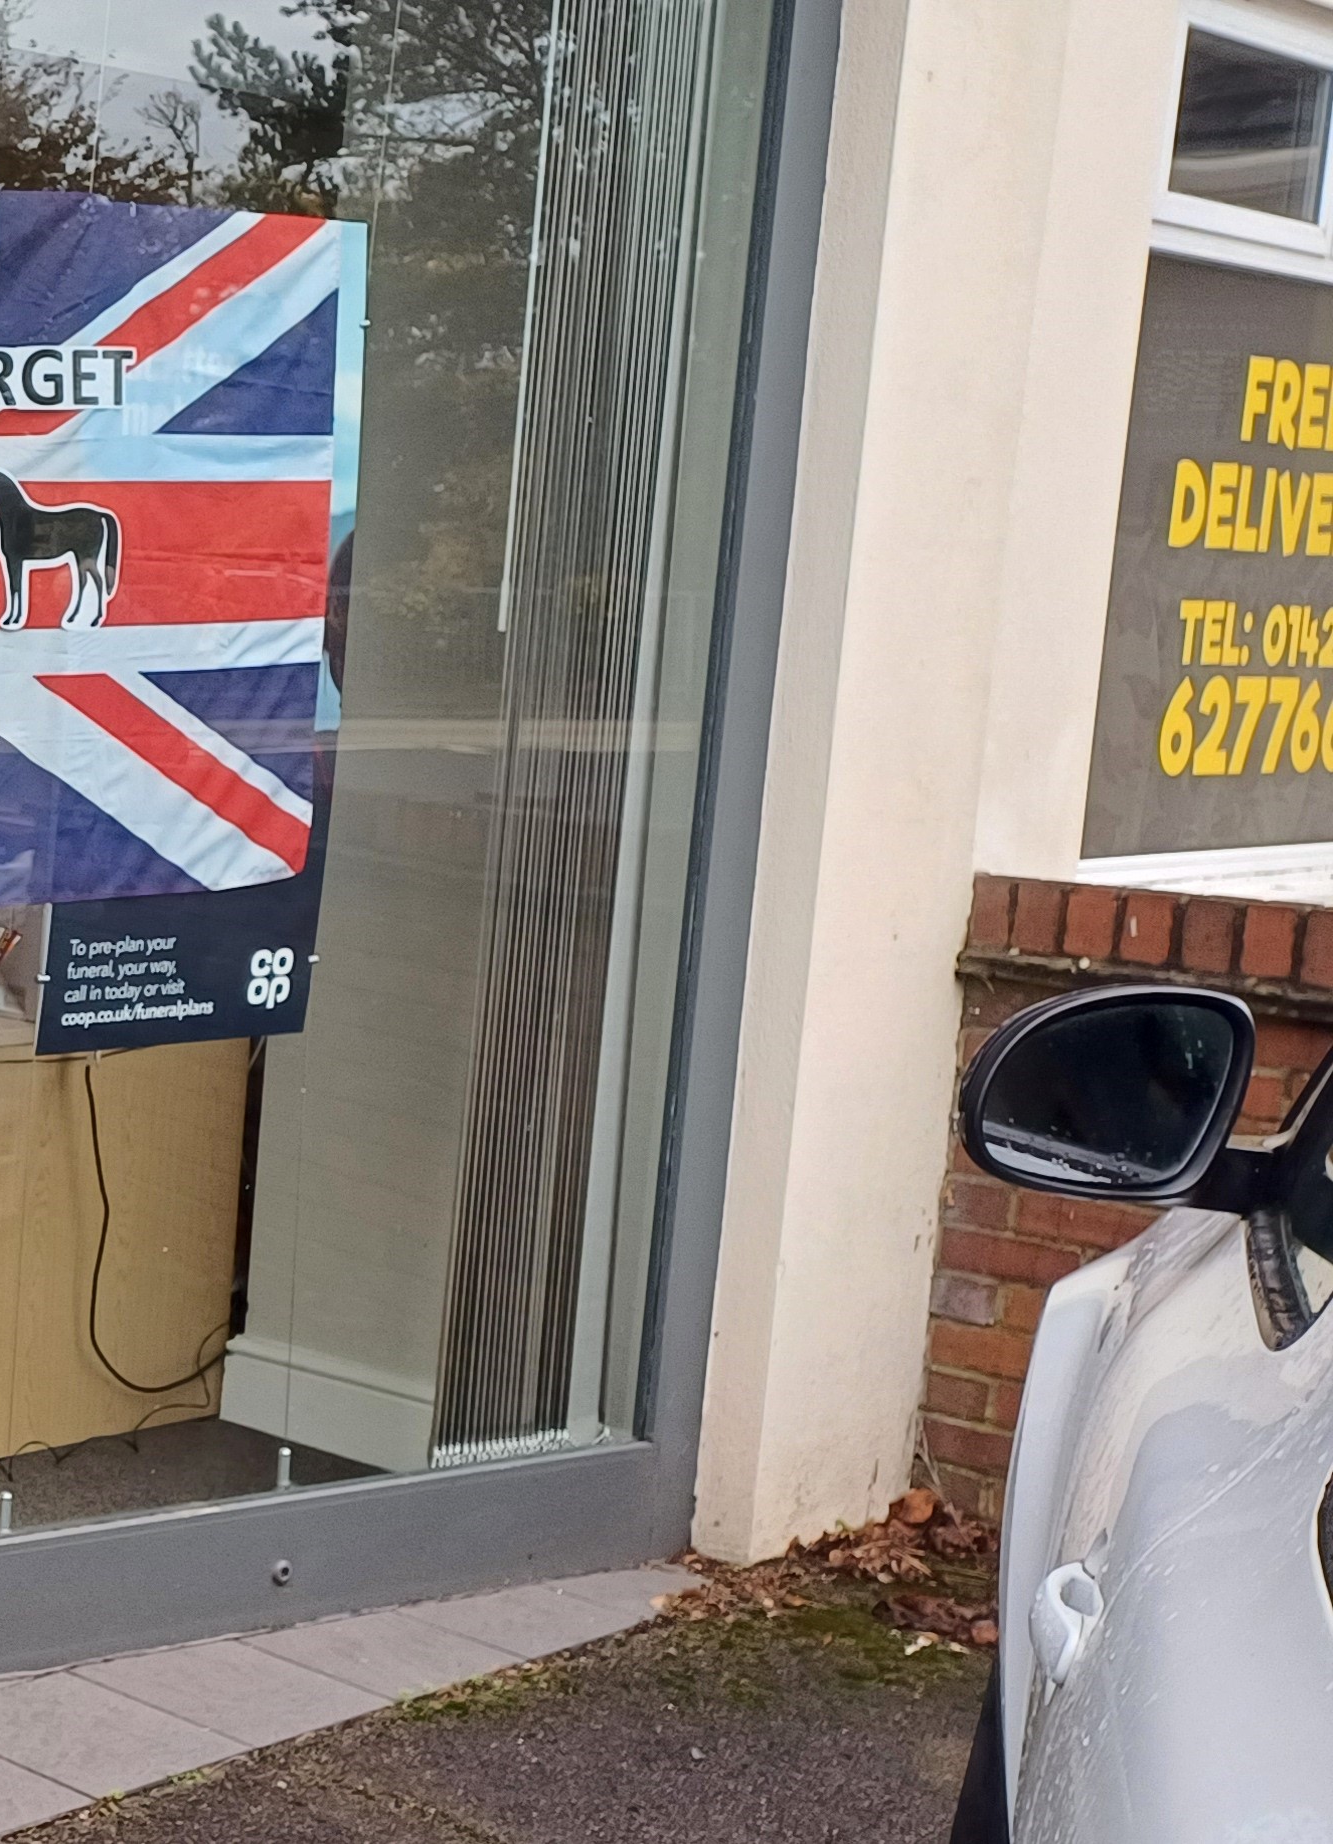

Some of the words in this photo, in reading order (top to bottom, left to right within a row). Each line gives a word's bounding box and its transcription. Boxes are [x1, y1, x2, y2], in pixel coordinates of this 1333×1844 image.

[1240, 355, 1333, 451] FRE
[1179, 599, 1253, 666] TEL:
[70, 938, 86, 956] To
[88, 935, 144, 959] pre-plan
[145, 937, 177, 956] your
[67, 959, 115, 979] funeral,
[117, 961, 149, 980] your
[64, 985, 87, 1003] call
[89, 985, 102, 1000] in
[105, 981, 142, 1002] today
[144, 983, 160, 997] or
[160, 978, 185, 995] visit
[61, 998, 214, 1029] coop.co.uk/funeralplans
